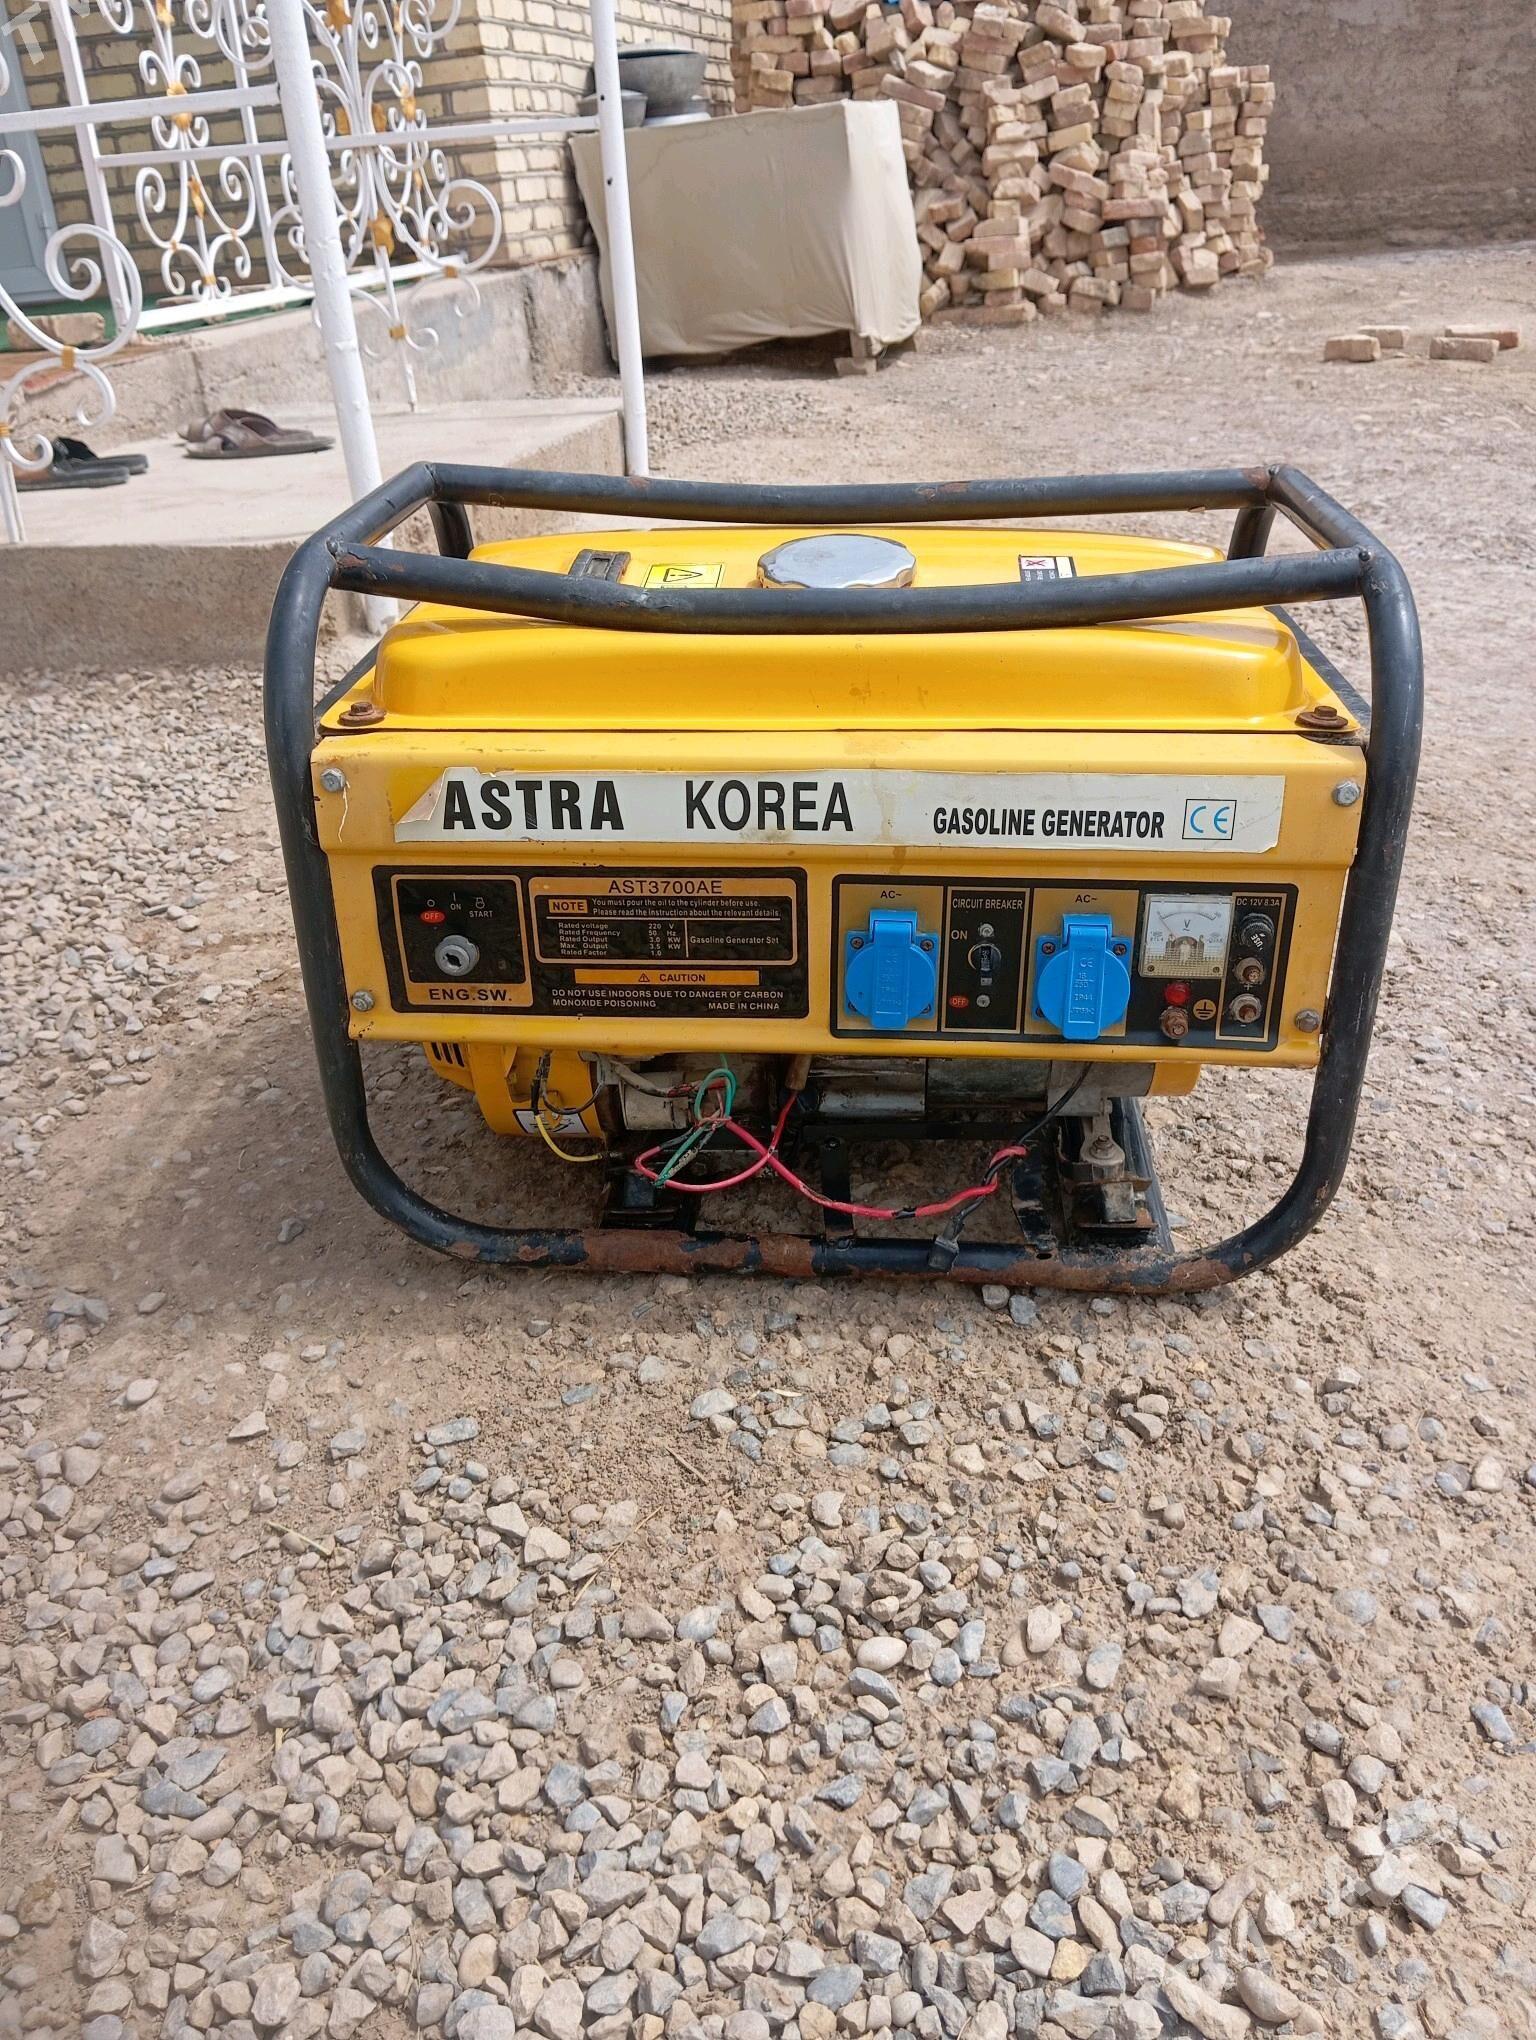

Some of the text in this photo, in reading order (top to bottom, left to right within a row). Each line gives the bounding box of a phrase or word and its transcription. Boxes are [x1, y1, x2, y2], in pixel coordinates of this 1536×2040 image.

[442, 779, 854, 832] ASTRA KOREA
[933, 807, 1165, 839] GASOLINE GENERATOR
[1189, 805, 1231, 834] CE
[608, 880, 723, 894] AST3700AE
[552, 901, 585, 911] NOTE
[592, 898, 606, 906] You
[626, 900, 643, 908] pour
[657, 899, 667, 907] oil
[668, 899, 676, 907] to
[677, 899, 689, 907] the
[689, 899, 719, 908] cylinder
[720, 899, 744, 907] before
[952, 898, 1023, 910] CIRCUIT BREAKER
[1236, 897, 1248, 906] DC
[1250, 898, 1263, 906] 12V
[450, 903, 462, 911] ON
[424, 911, 440, 920] OFF
[469, 910, 493, 918] START
[592, 908, 617, 916] Please
[618, 908, 635, 916] read
[635, 908, 648, 916] the
[689, 909, 710, 917] about
[711, 909, 723, 917] the
[723, 909, 754, 917] relevant
[581, 922, 609, 930] voltage
[581, 929, 621, 937] Frequency
[951, 929, 968, 940] ON
[690, 935, 779, 944] Gasoline Generator Set
[659, 973, 706, 982] CAUTION
[551, 989, 784, 999] DO NOT USE INDOORS DUE TO DANGER OF CARBON
[552, 998, 657, 1008] MONOXIDE POISONING
[708, 1002, 780, 1010] MADE IN CHINA
[951, 997, 966, 1006] OFF
